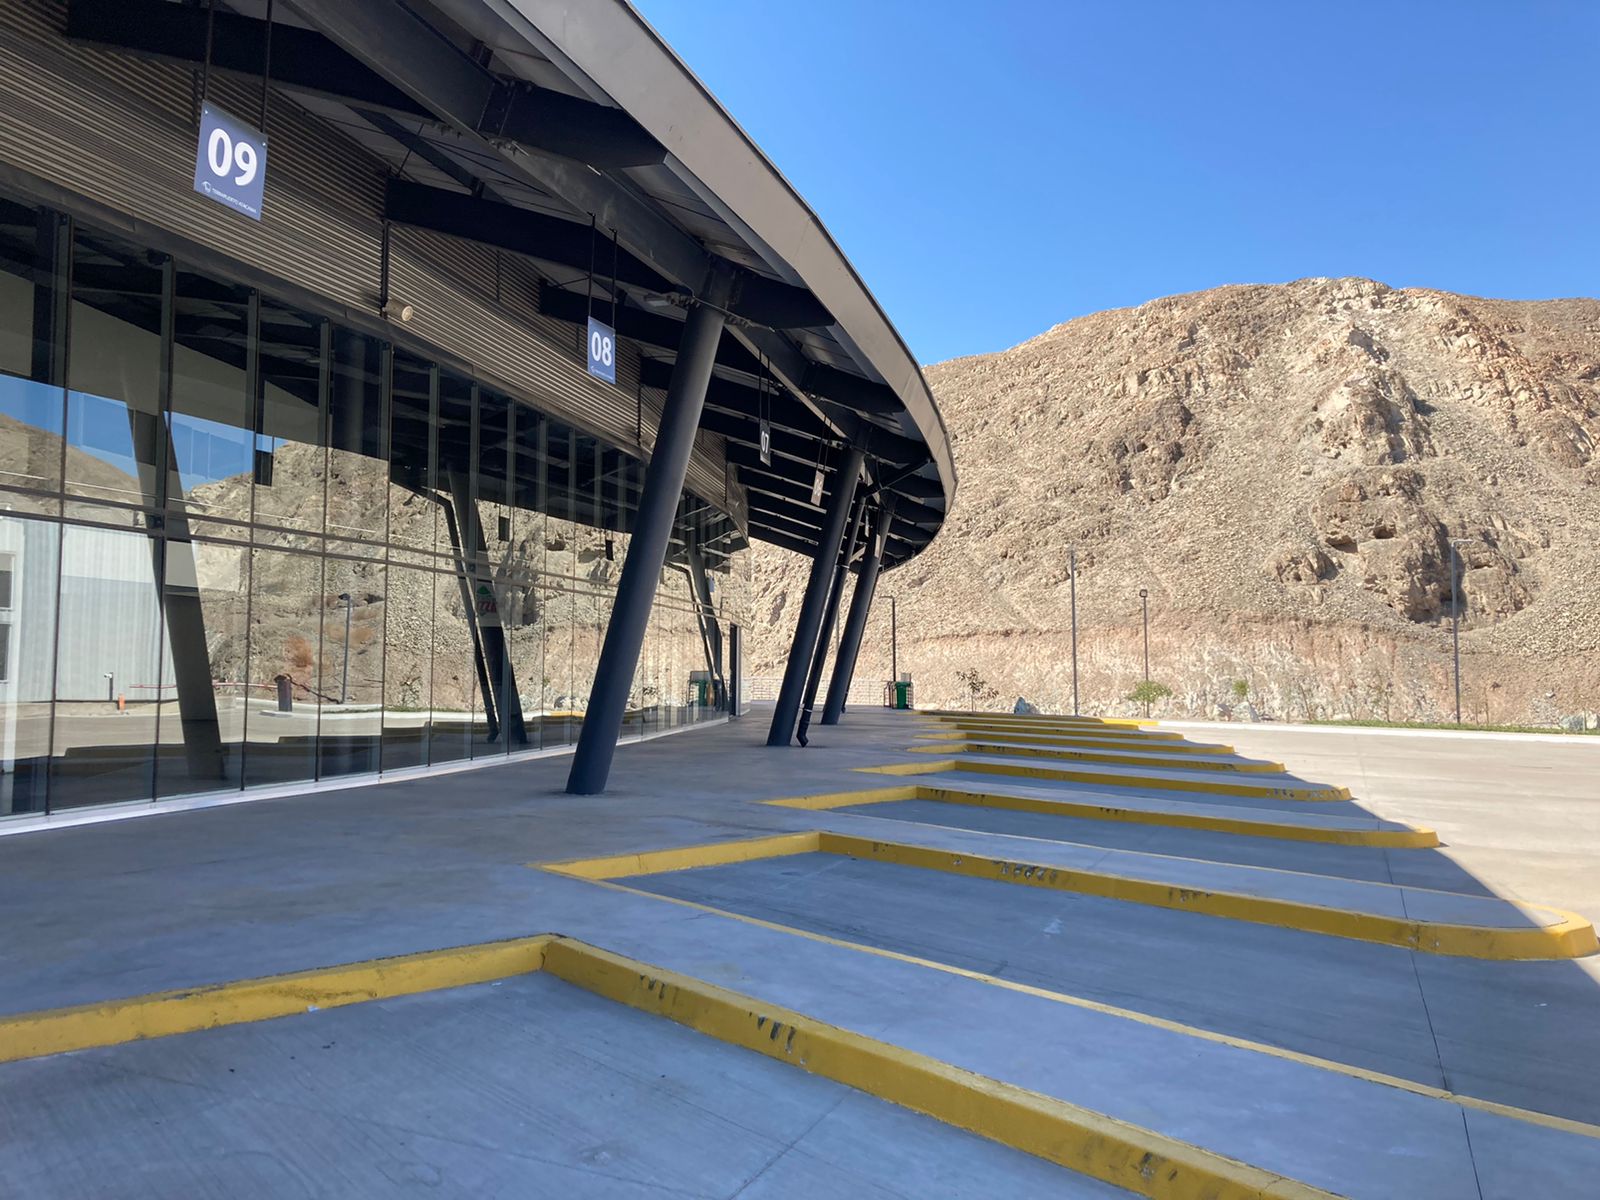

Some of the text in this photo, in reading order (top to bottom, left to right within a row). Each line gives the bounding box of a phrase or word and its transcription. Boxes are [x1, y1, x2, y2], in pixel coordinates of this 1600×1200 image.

[208, 128, 257, 186] 09
[591, 331, 612, 367] 08
[760, 430, 770, 454] 07
